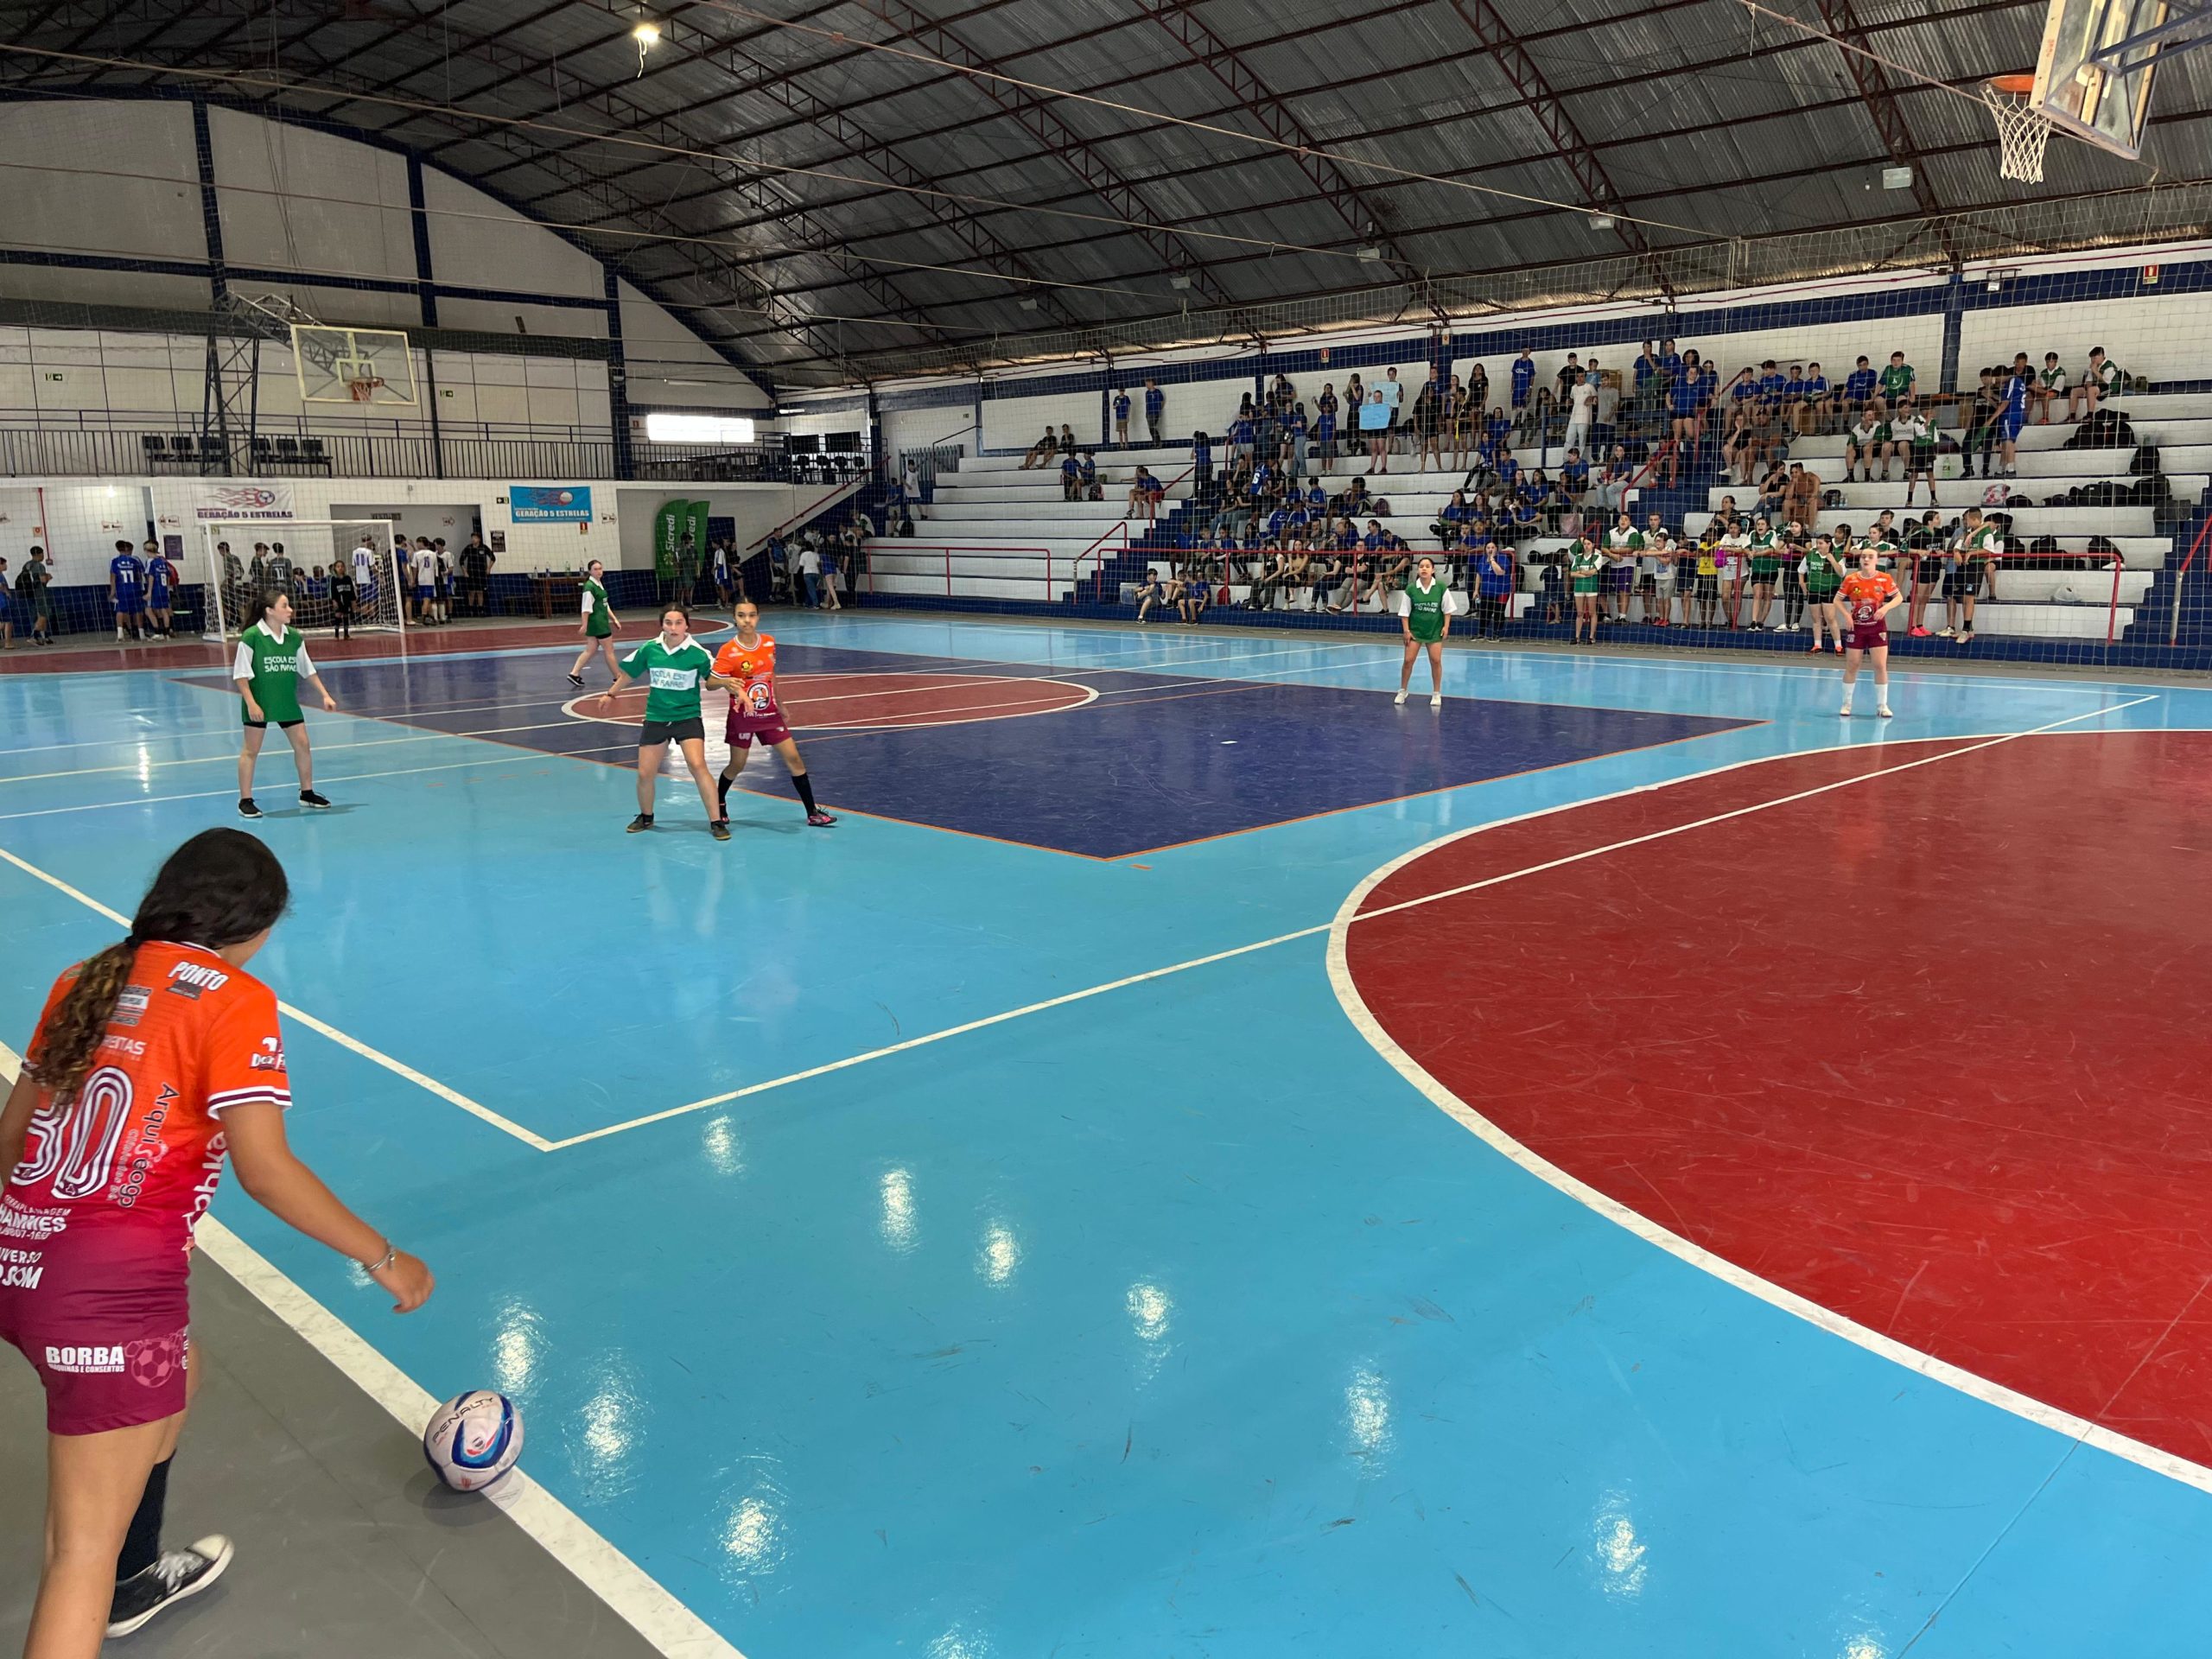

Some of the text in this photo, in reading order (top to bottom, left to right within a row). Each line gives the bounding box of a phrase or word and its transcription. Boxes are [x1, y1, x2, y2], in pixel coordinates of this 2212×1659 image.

[198, 511, 239, 520] GERAÇÃO
[516, 509, 549, 518] GERAÇÃO
[665, 514, 676, 551] Sicredi
[121, 570, 134, 583] 11
[264, 656, 287, 664] ESCOLA
[264, 664, 279, 672] SÃO
[168, 961, 230, 991] PONTO
[46, 1346, 125, 1365] BORBA
[432, 1397, 493, 1444] PENALTY
